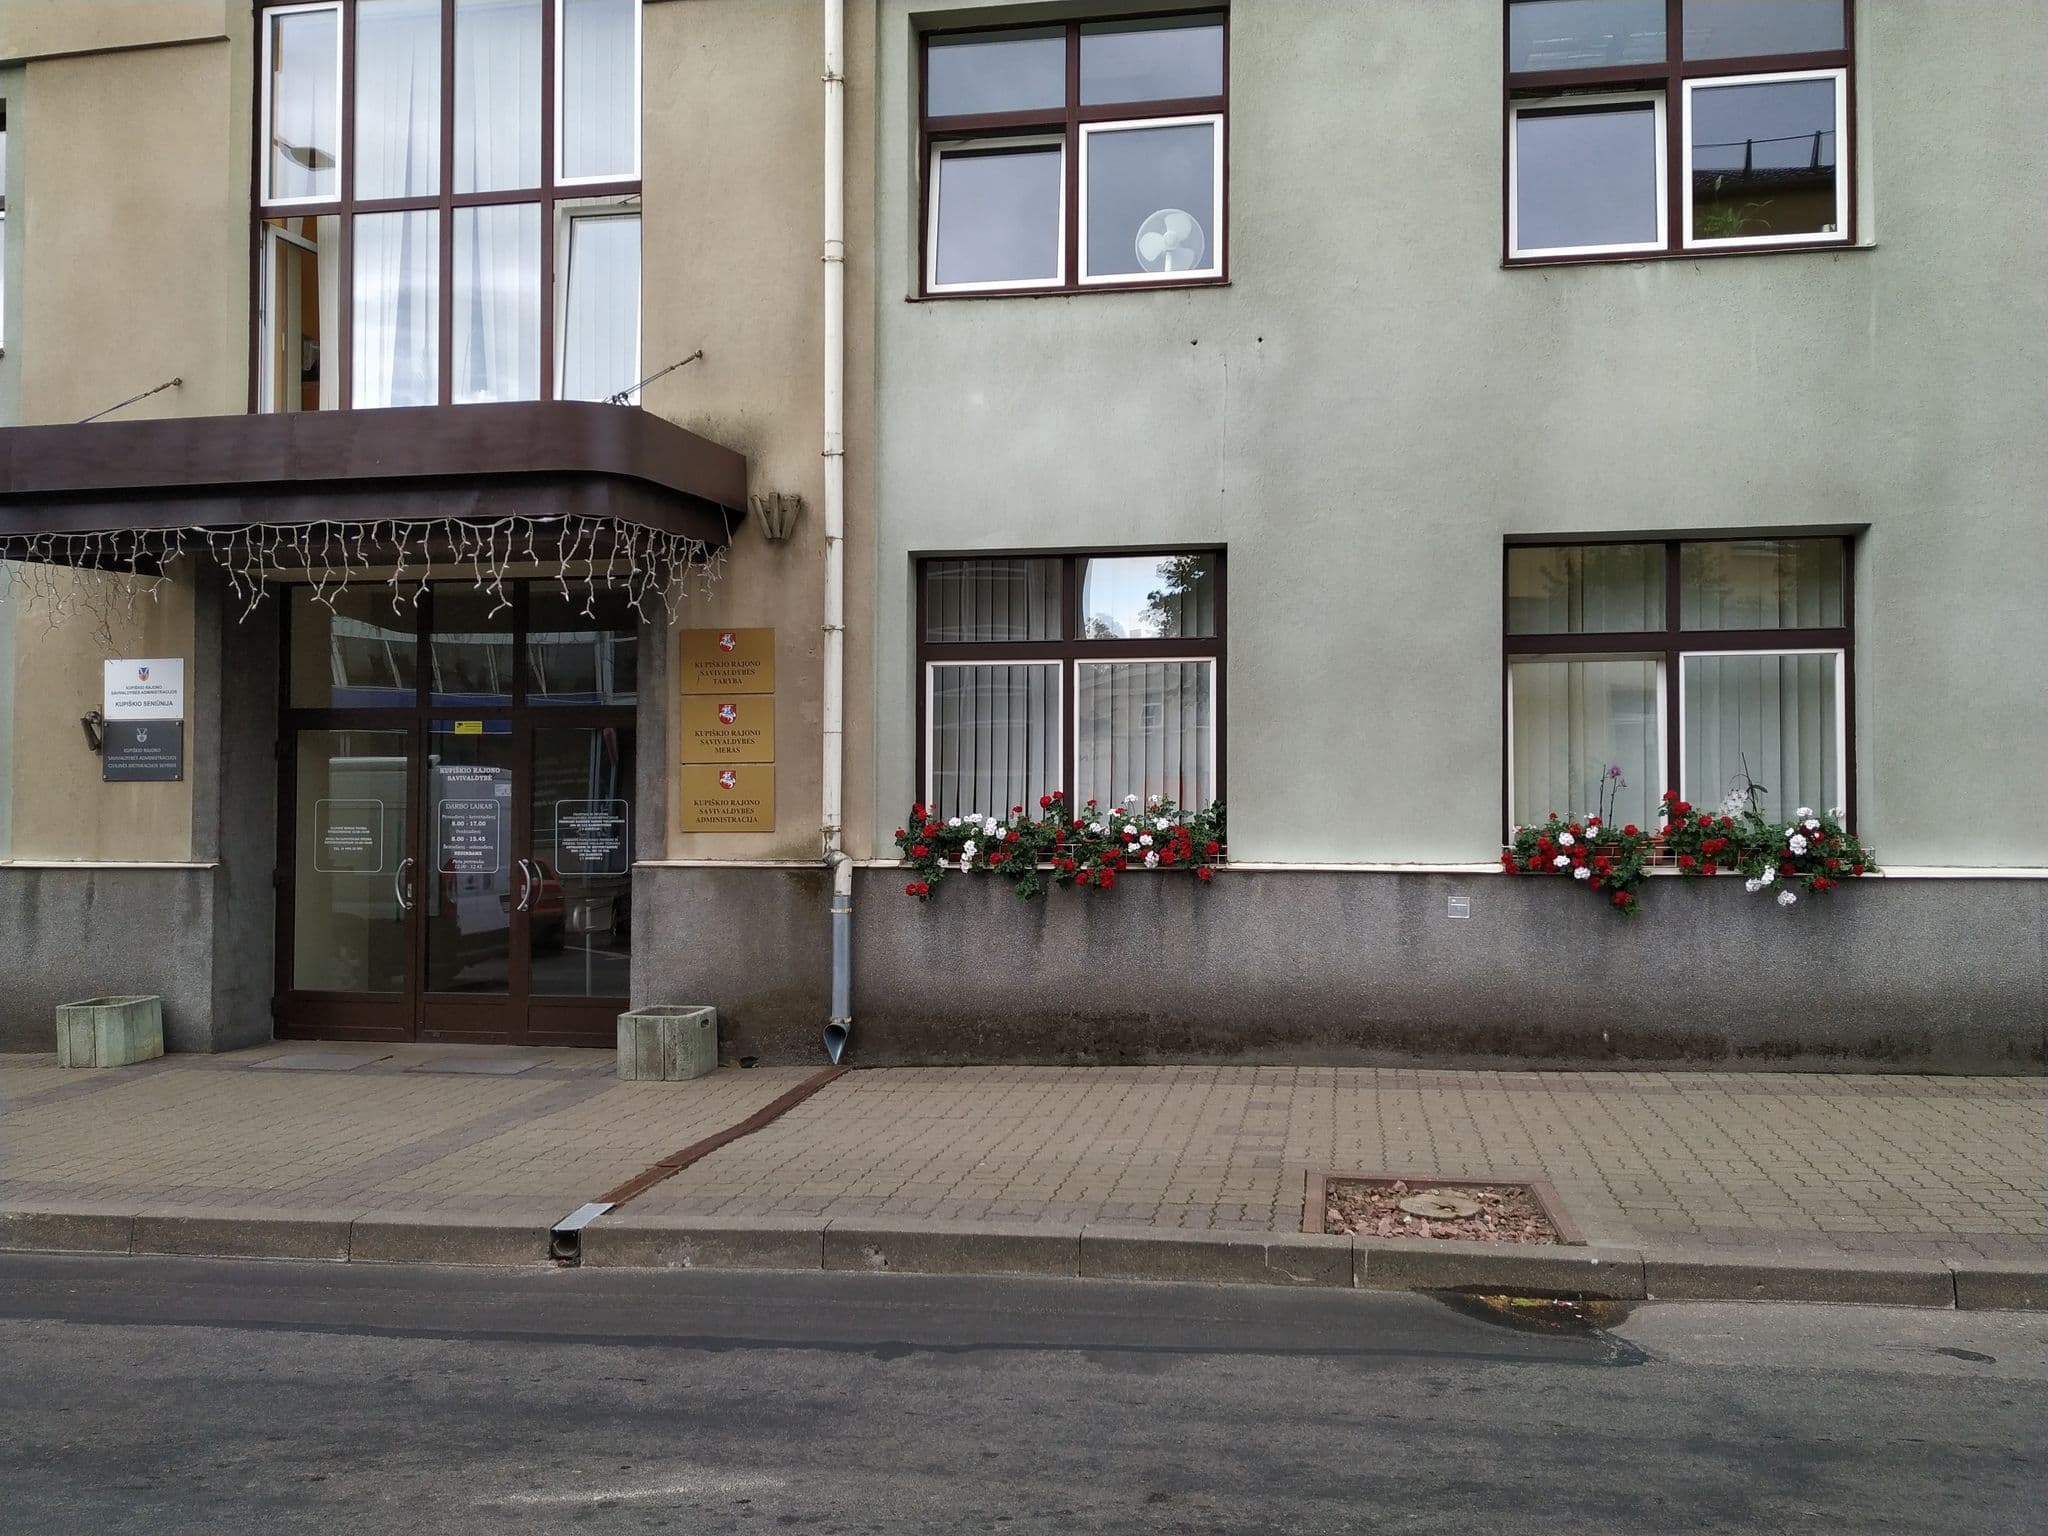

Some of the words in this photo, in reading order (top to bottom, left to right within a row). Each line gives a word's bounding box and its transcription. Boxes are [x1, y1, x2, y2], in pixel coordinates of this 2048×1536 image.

[695, 659, 730, 668] KUPIŠKIO
[731, 660, 761, 668] RAJONO
[700, 668, 756, 676] SAVIVALDYBĖS
[694, 728, 730, 737] KUPIŠKIO
[731, 729, 761, 737] RAJONO
[700, 737, 756, 745] SAVIVALDYBĖS
[439, 766, 471, 774] KUPIŠKIO
[693, 798, 729, 806] KUPIŠKIO
[699, 807, 755, 815] SAVIVALDYBĖS
